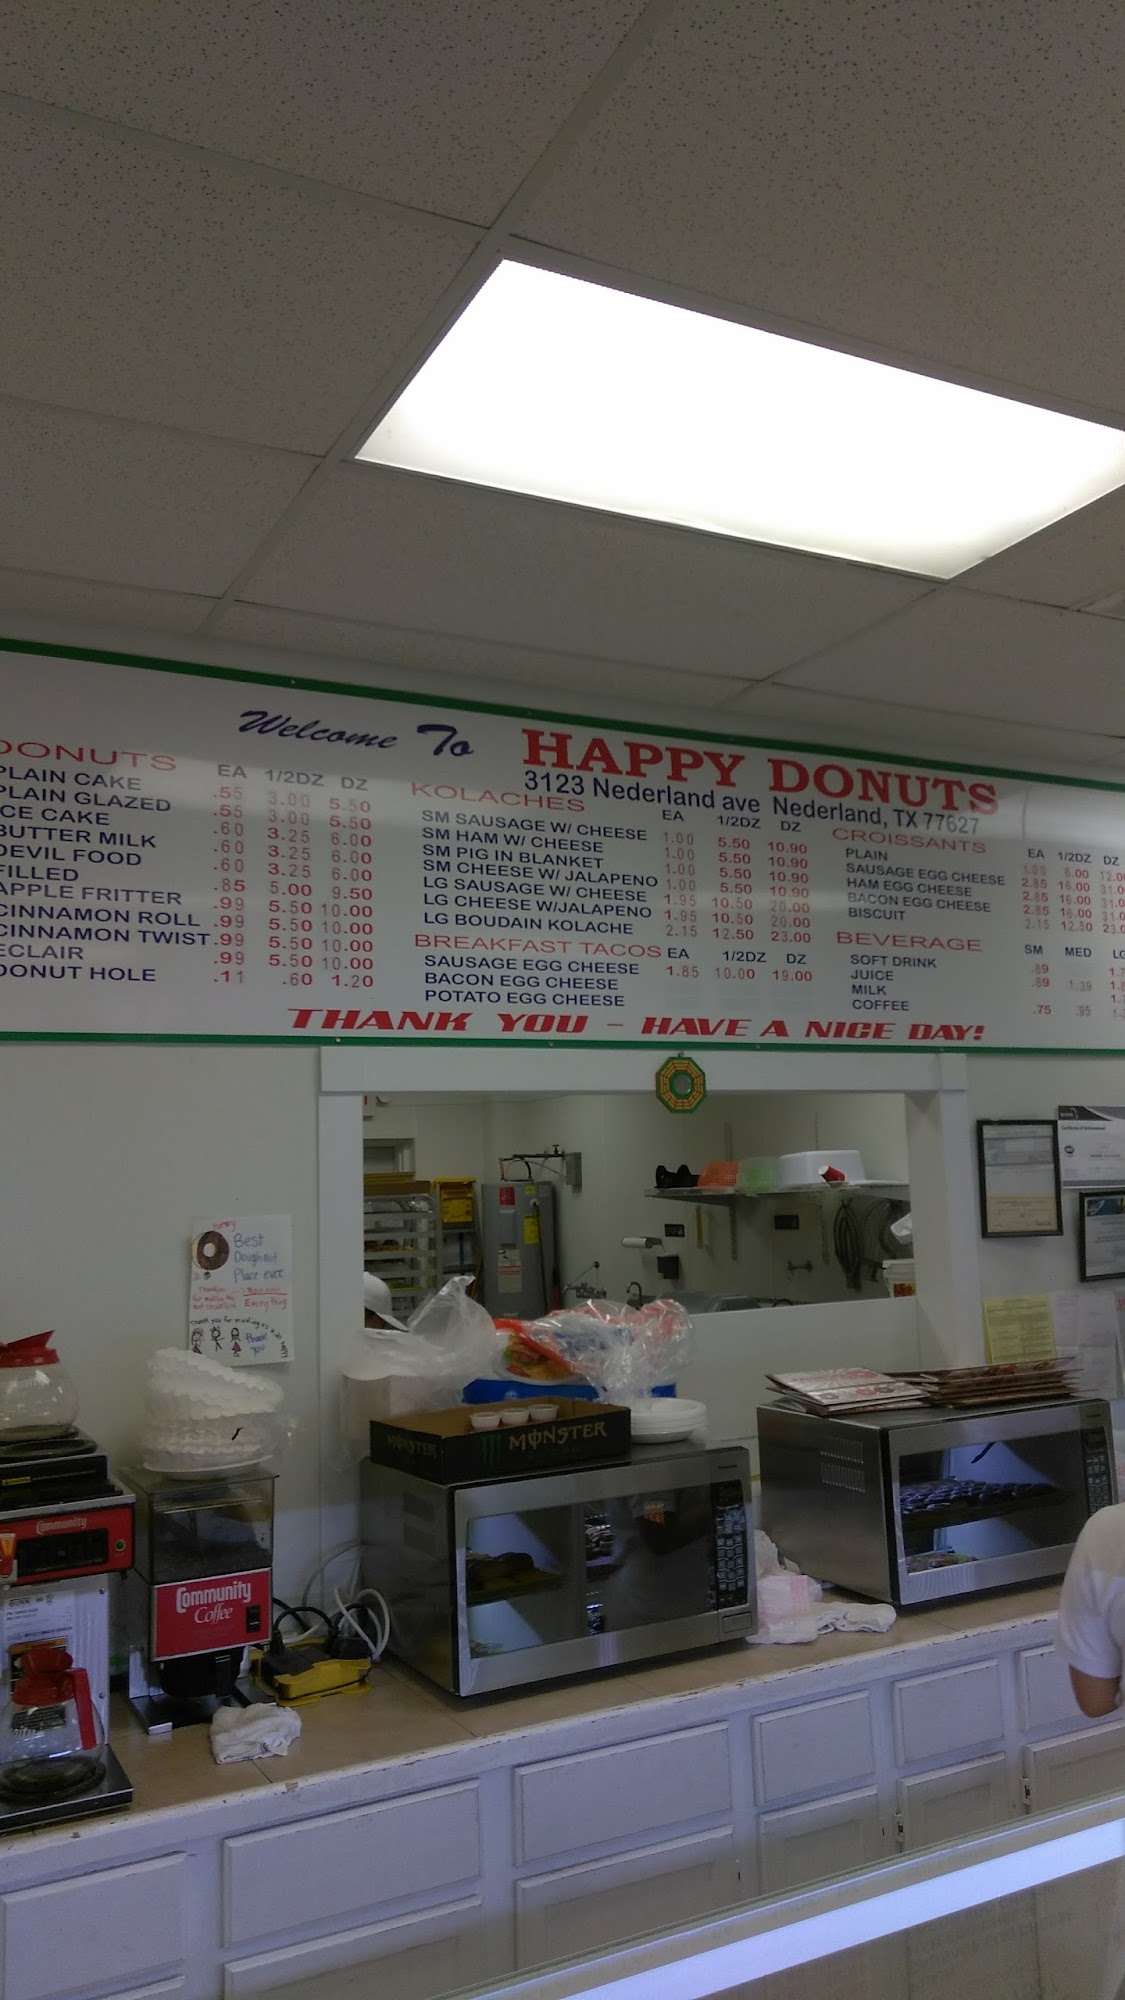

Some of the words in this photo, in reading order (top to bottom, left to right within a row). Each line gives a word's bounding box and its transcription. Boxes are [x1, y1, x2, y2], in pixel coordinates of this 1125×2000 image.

[239, 710, 397, 748] Welcome
[417, 724, 474, 757] To
[74, 772, 141, 791] CAKE
[218, 764, 247, 779] EA
[265, 769, 324, 786] 1/2DZ
[341, 777, 368, 791] DZ
[522, 729, 745, 787] HAPPY
[767, 758, 999, 815] DONUTS
[74, 792, 171, 811] GLAZED
[329, 815, 372, 830] 5.50
[412, 782, 585, 812] KOLACHES
[662, 809, 684, 822] EA
[717, 815, 760, 829] 1/2DZ
[781, 821, 801, 832] DZ
[525, 770, 584, 795] 3123
[593, 777, 715, 808] Nederland
[722, 796, 760, 813] ave
[773, 796, 887, 829] Nederland,
[893, 809, 917, 828] TX
[923, 812, 979, 835] 77627
[41, 808, 109, 825] CAKE
[213, 821, 244, 837] .60
[267, 827, 310, 844] 3.25
[331, 832, 372, 847] 6.00
[422, 810, 449, 823] SM
[456, 813, 545, 832] SAUSAGE
[550, 822, 572, 834] W/
[577, 824, 647, 843] CHEESE
[718, 836, 750, 850] 5.50
[768, 841, 807, 854] 10.90
[422, 827, 450, 840] SM
[457, 830, 498, 844] HAM
[503, 834, 526, 846] W/
[531, 836, 603, 853] CHEESE
[99, 832, 156, 848] MILK
[214, 839, 244, 854] .60
[268, 845, 310, 861] 3.25
[332, 849, 372, 864] 6.00
[423, 844, 450, 857] SM
[457, 847, 488, 860] PIG
[495, 850, 513, 862] IN
[519, 852, 603, 869] BLANKET
[832, 828, 986, 853] CROISSANTS
[1028, 848, 1045, 859] EA
[1058, 852, 1092, 863] 1/2DZ
[1104, 856, 1119, 866] DZ
[845, 847, 888, 861] PLAIN
[73, 849, 141, 865] FOOD
[214, 857, 244, 873] .60
[268, 862, 311, 878] 3.25
[332, 867, 372, 882] 6.00
[423, 859, 450, 872] SM
[457, 862, 533, 878] CHEESE
[538, 868, 560, 880] W/
[565, 870, 658, 887] JALAPENO
[846, 863, 914, 878] SAUSAGE
[918, 869, 948, 881] EGG
[951, 872, 1005, 886] CHEESE
[214, 878, 245, 892] .85
[270, 881, 312, 897] 5.00
[332, 886, 373, 900] 9.50
[424, 876, 448, 889] LG
[454, 879, 544, 895] SAUSAGE
[549, 885, 571, 897] W/
[576, 887, 646, 902] CHEESE
[847, 877, 879, 889] HAM
[883, 880, 914, 893] EGG
[917, 882, 972, 897] CHEESE
[82, 887, 181, 905] FRITTER
[214, 896, 244, 911] .99
[269, 900, 312, 914] 5.50
[322, 904, 373, 918] 10.00
[424, 893, 448, 906] LG
[454, 895, 531, 911] CHEESE
[848, 892, 899, 906] BACON
[902, 896, 933, 908] EGG
[936, 899, 991, 912] CHEESE
[848, 907, 906, 921] BISCUIT
[138, 911, 200, 926] ROLL
[214, 914, 244, 928] .99
[269, 918, 313, 932] 5.50
[322, 921, 373, 935] 10.00
[424, 912, 448, 924] LG
[455, 914, 542, 930] BOUDAIN
[548, 919, 633, 934] KOLACHE
[666, 924, 698, 938] 2.15
[713, 928, 754, 940] 12.50
[771, 931, 811, 943] 23.00
[137, 930, 210, 945] TWIST
[214, 933, 244, 947] .99
[269, 936, 313, 950] 5.50
[322, 939, 373, 953] 10.00
[415, 934, 572, 953] BREAKFAST
[579, 942, 661, 958] TACOS
[668, 948, 689, 959] EA
[723, 951, 766, 963] 1/2DZ
[787, 953, 806, 964] DZ
[836, 931, 981, 952] BEVERAGE
[1025, 944, 1043, 954] SM
[1065, 947, 1092, 957] MED
[214, 951, 244, 965] .99
[269, 954, 313, 968] 5.50
[425, 955, 517, 970] SAUSAGE
[523, 959, 562, 972] EGG
[568, 961, 639, 974] CHEESE
[666, 965, 699, 979] 1.85
[772, 970, 812, 981] 19.00
[850, 954, 888, 966] SOFT
[892, 956, 936, 968] DRINK
[90, 967, 156, 981] HOLE
[214, 970, 243, 984] .11
[283, 973, 313, 986] .60
[331, 974, 373, 988] 1.20
[425, 972, 493, 986] BACON
[500, 975, 540, 987] EGG
[545, 977, 618, 990] CHEESE
[851, 969, 893, 981] JUICE
[425, 990, 501, 1003] POTATO
[507, 992, 546, 1004] EGG
[552, 993, 624, 1006] CHEESE
[852, 984, 886, 995] MILK
[852, 999, 909, 1011] COFFEE
[288, 1009, 473, 1031] THANK
[497, 1014, 588, 1033] YOU
[641, 1017, 751, 1036] HAVE
[760, 1020, 789, 1037] A
[805, 1021, 896, 1039] NICE
[908, 1024, 985, 1041] DAY!
[508, 1421, 608, 1450] MONSTER
[36, 1517, 87, 1535] Community
[176, 1581, 251, 1613] Community
[194, 1604, 233, 1624] Coffee
